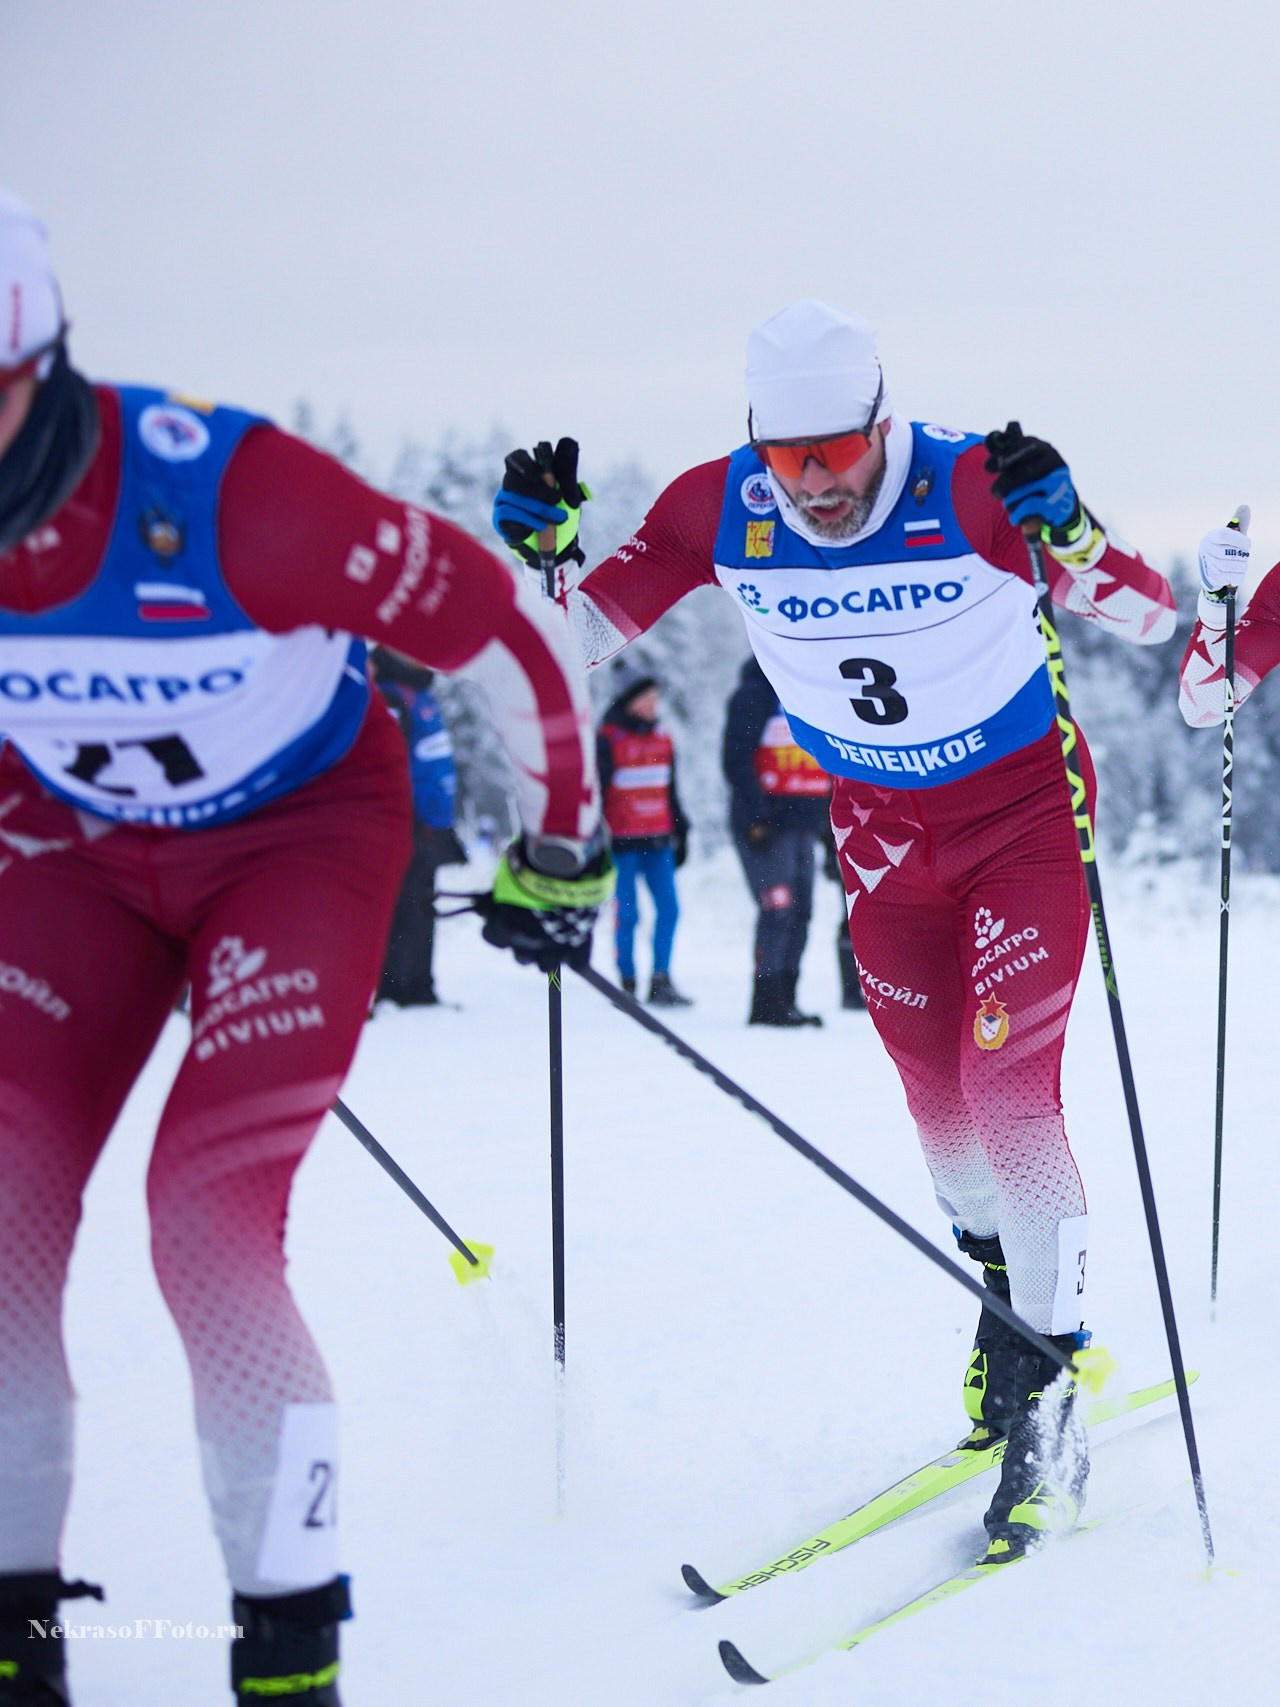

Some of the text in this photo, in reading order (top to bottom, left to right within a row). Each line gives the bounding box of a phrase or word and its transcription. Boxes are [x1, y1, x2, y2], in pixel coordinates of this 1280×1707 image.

[778, 581, 964, 622] ФОСАГРО
[839, 658, 909, 725] 3
[825, 729, 986, 776] ЧЕПЕЦКОЕ
[975, 946, 1049, 996] BIVIUM
[304, 1461, 337, 1528] 2
[729, 1538, 832, 1591] FISCHER
